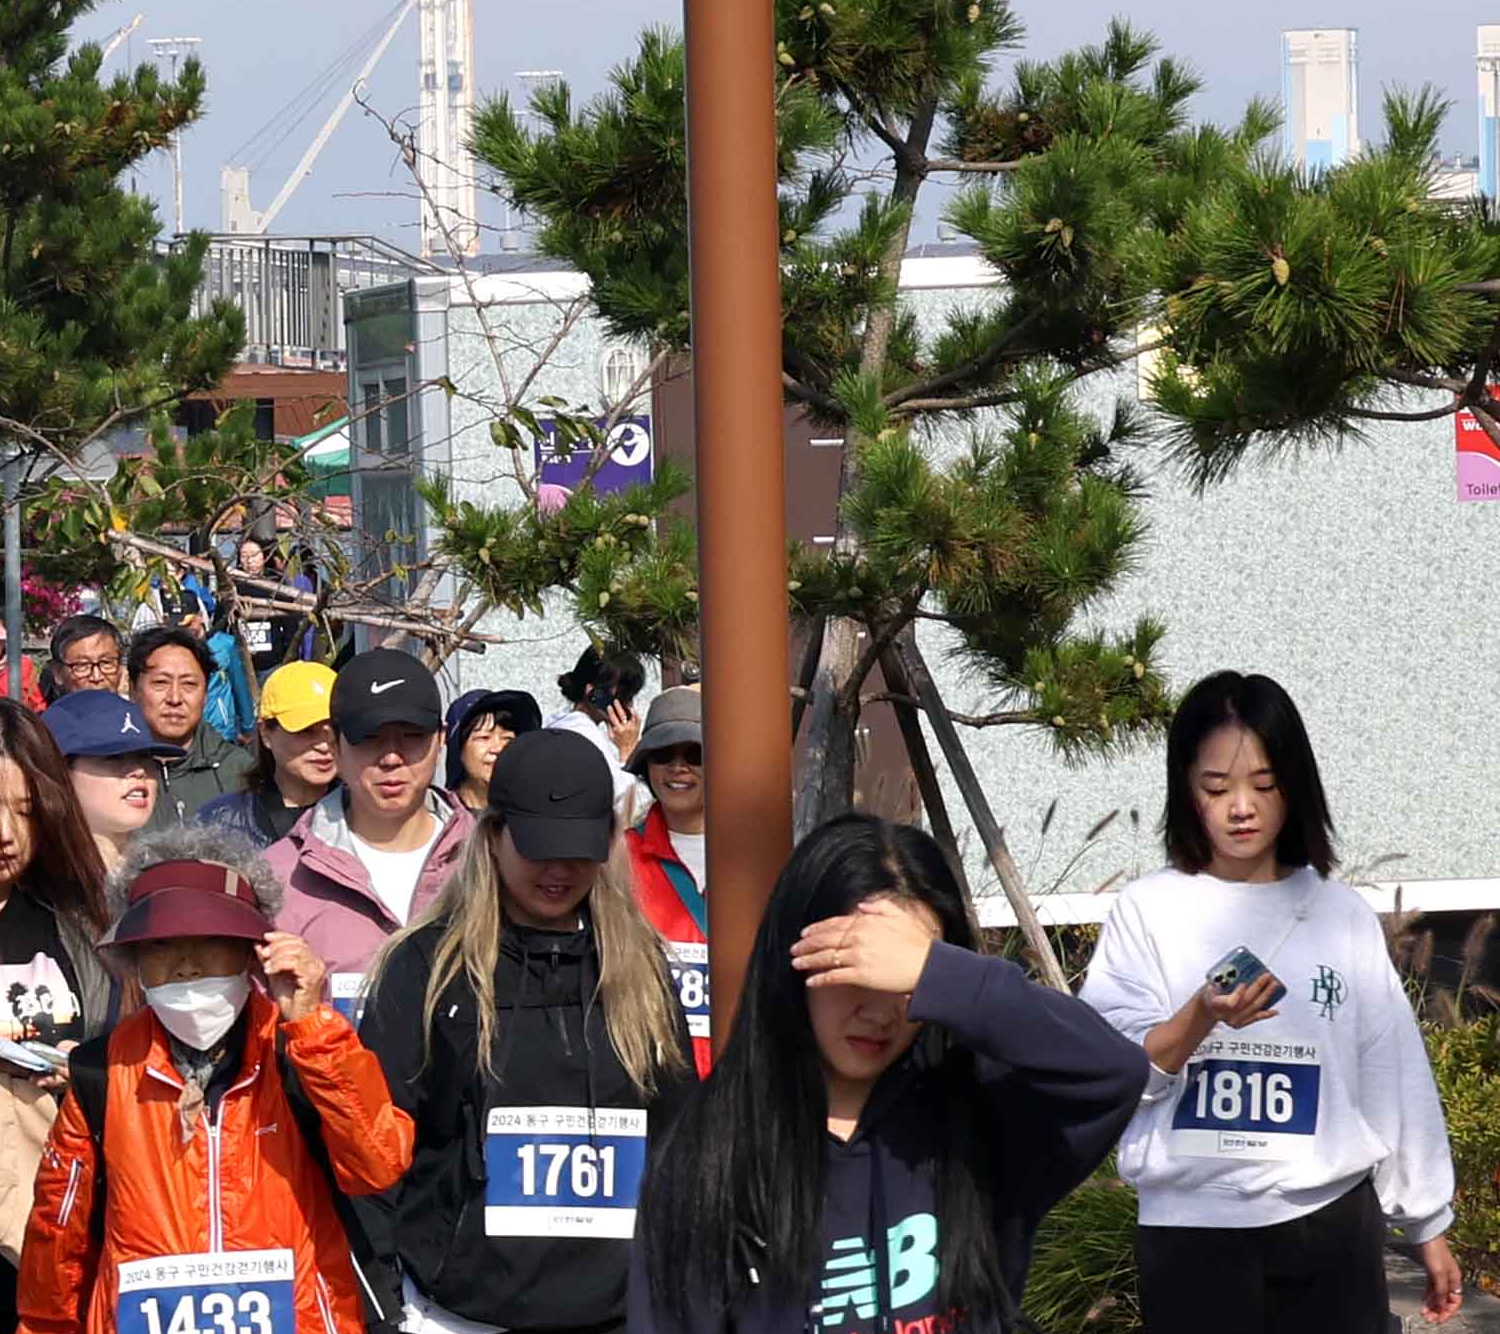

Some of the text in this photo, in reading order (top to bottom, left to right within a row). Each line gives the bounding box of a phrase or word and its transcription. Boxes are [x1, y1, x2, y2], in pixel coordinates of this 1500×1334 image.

[1229, 1042, 1317, 1058] 구민건강걷기행사
[1196, 1069, 1293, 1124] 1816
[491, 1114, 522, 1126] 2024
[527, 1114, 549, 1127] 동구
[517, 1144, 615, 1197] 1761
[124, 1268, 151, 1284] 2024
[184, 1258, 288, 1278] 구민건강걷기행사
